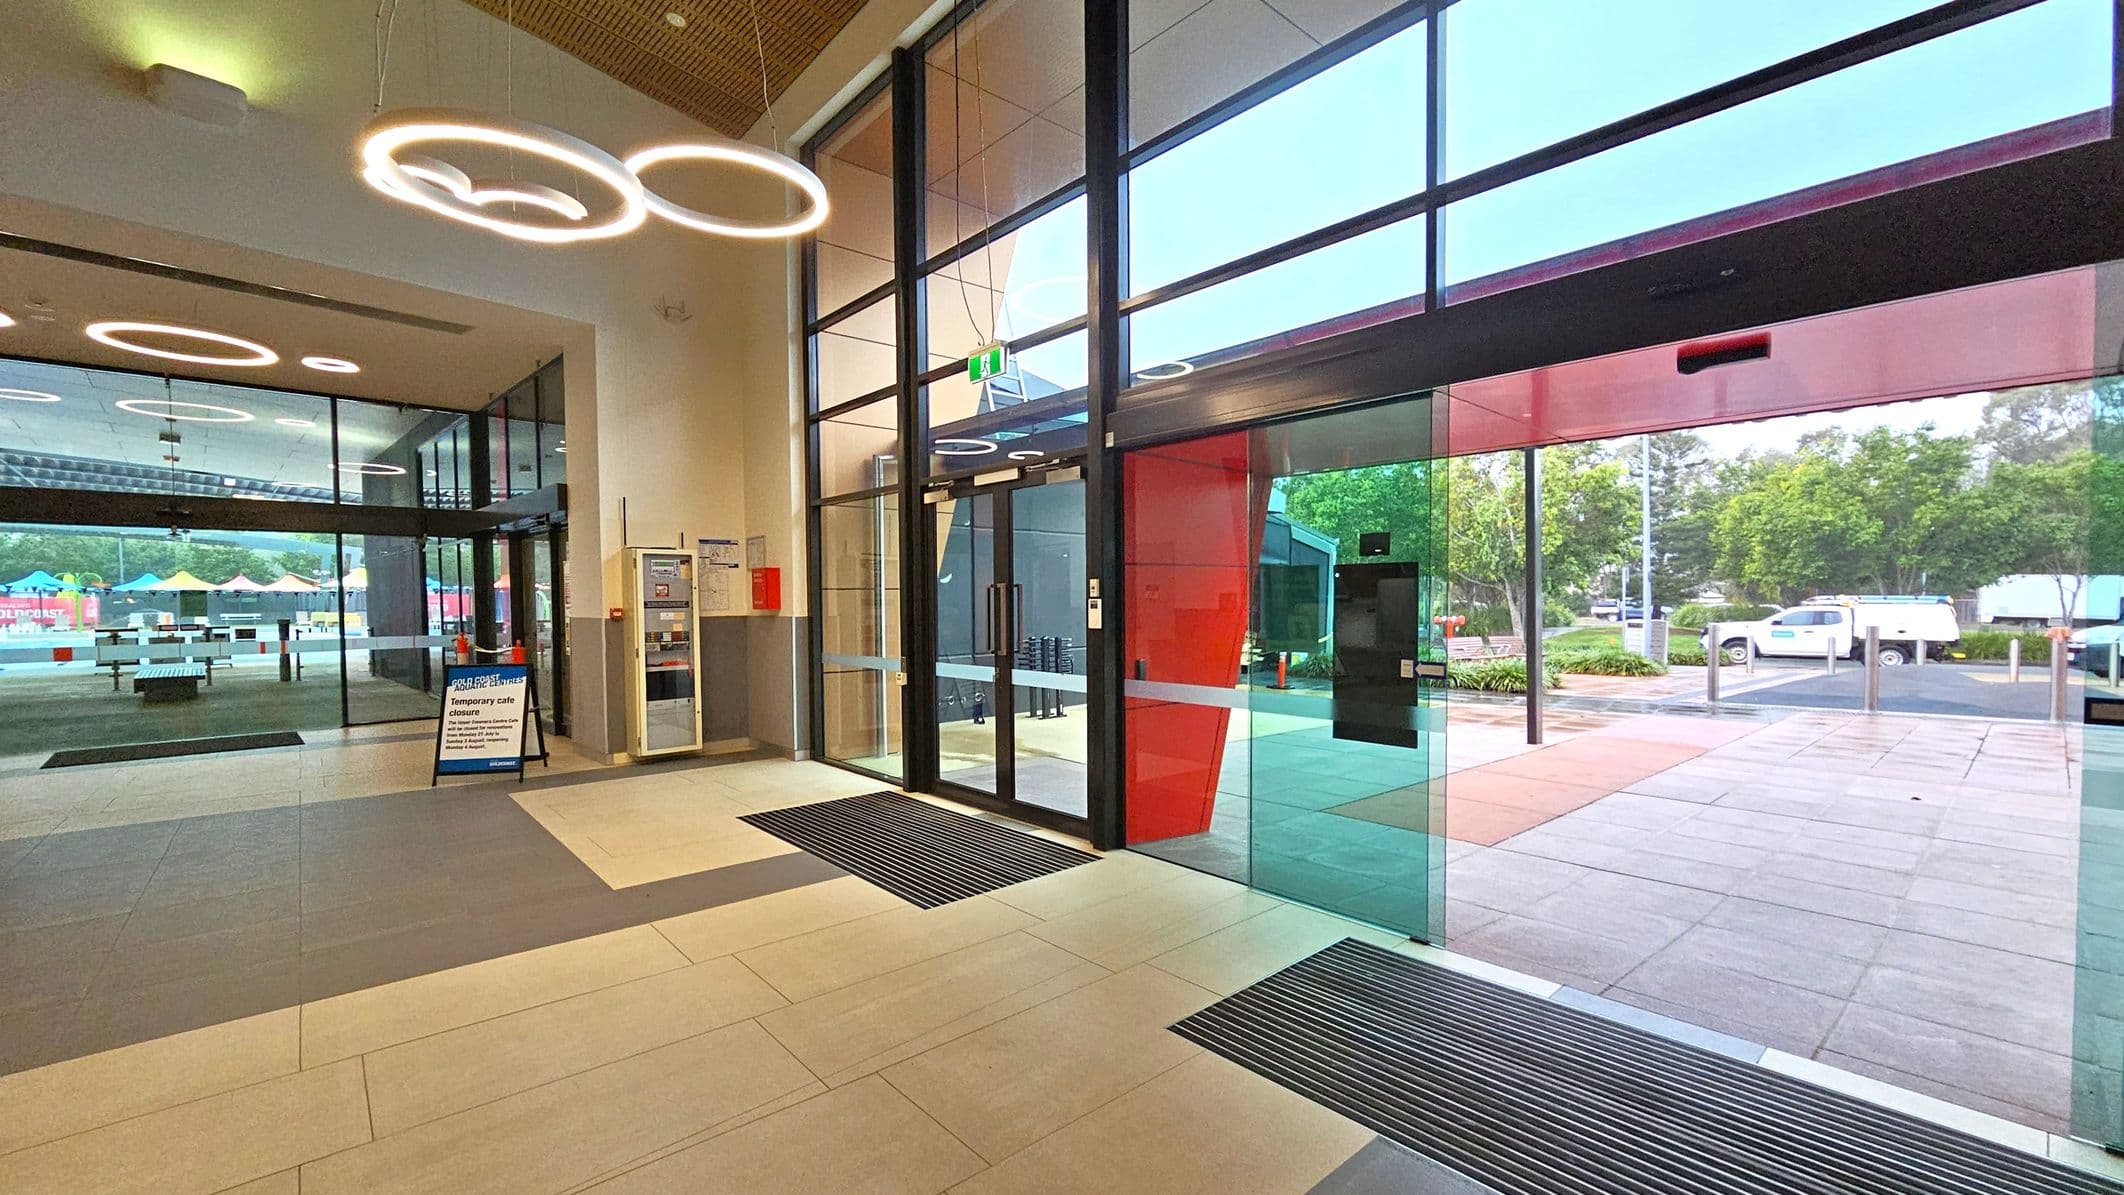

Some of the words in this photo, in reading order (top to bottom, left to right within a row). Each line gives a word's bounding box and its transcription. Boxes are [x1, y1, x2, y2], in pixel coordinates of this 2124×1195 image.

[452, 677, 473, 687] GOLD
[474, 674, 500, 683] COAST
[454, 681, 487, 692] AQUATIC
[489, 677, 524, 687] CENTRES
[451, 697, 495, 706] Temporary
[497, 696, 515, 704] cafe
[449, 709, 480, 717] closure
